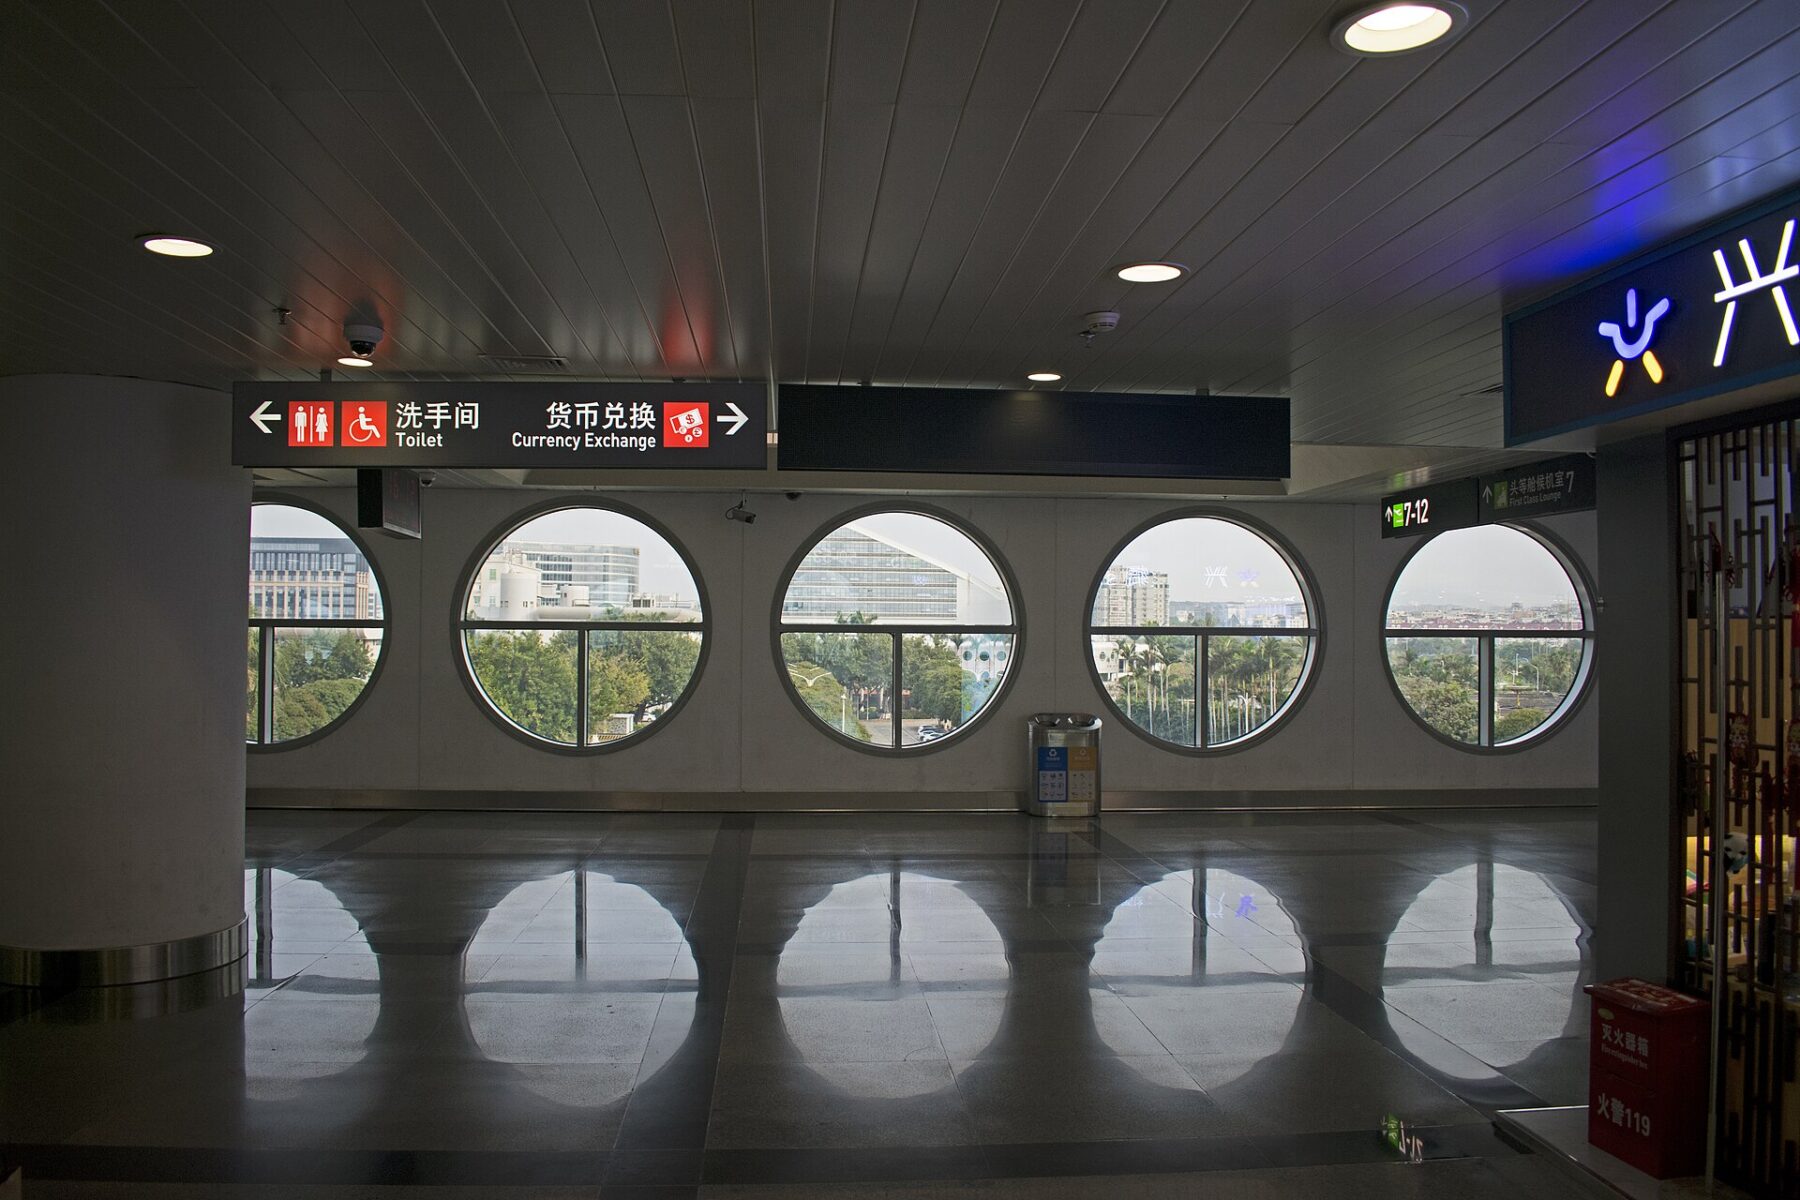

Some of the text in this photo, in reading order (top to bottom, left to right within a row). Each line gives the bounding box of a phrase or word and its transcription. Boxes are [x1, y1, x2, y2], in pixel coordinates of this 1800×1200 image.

[395, 401, 479, 430] 洗手间
[546, 402, 656, 430] 货币兑换
[395, 431, 443, 448] Toilet
[511, 431, 656, 452] Currency Exchange
[1403, 498, 1430, 527] 7-12
[1601, 1023, 1648, 1057] 灭火器箱
